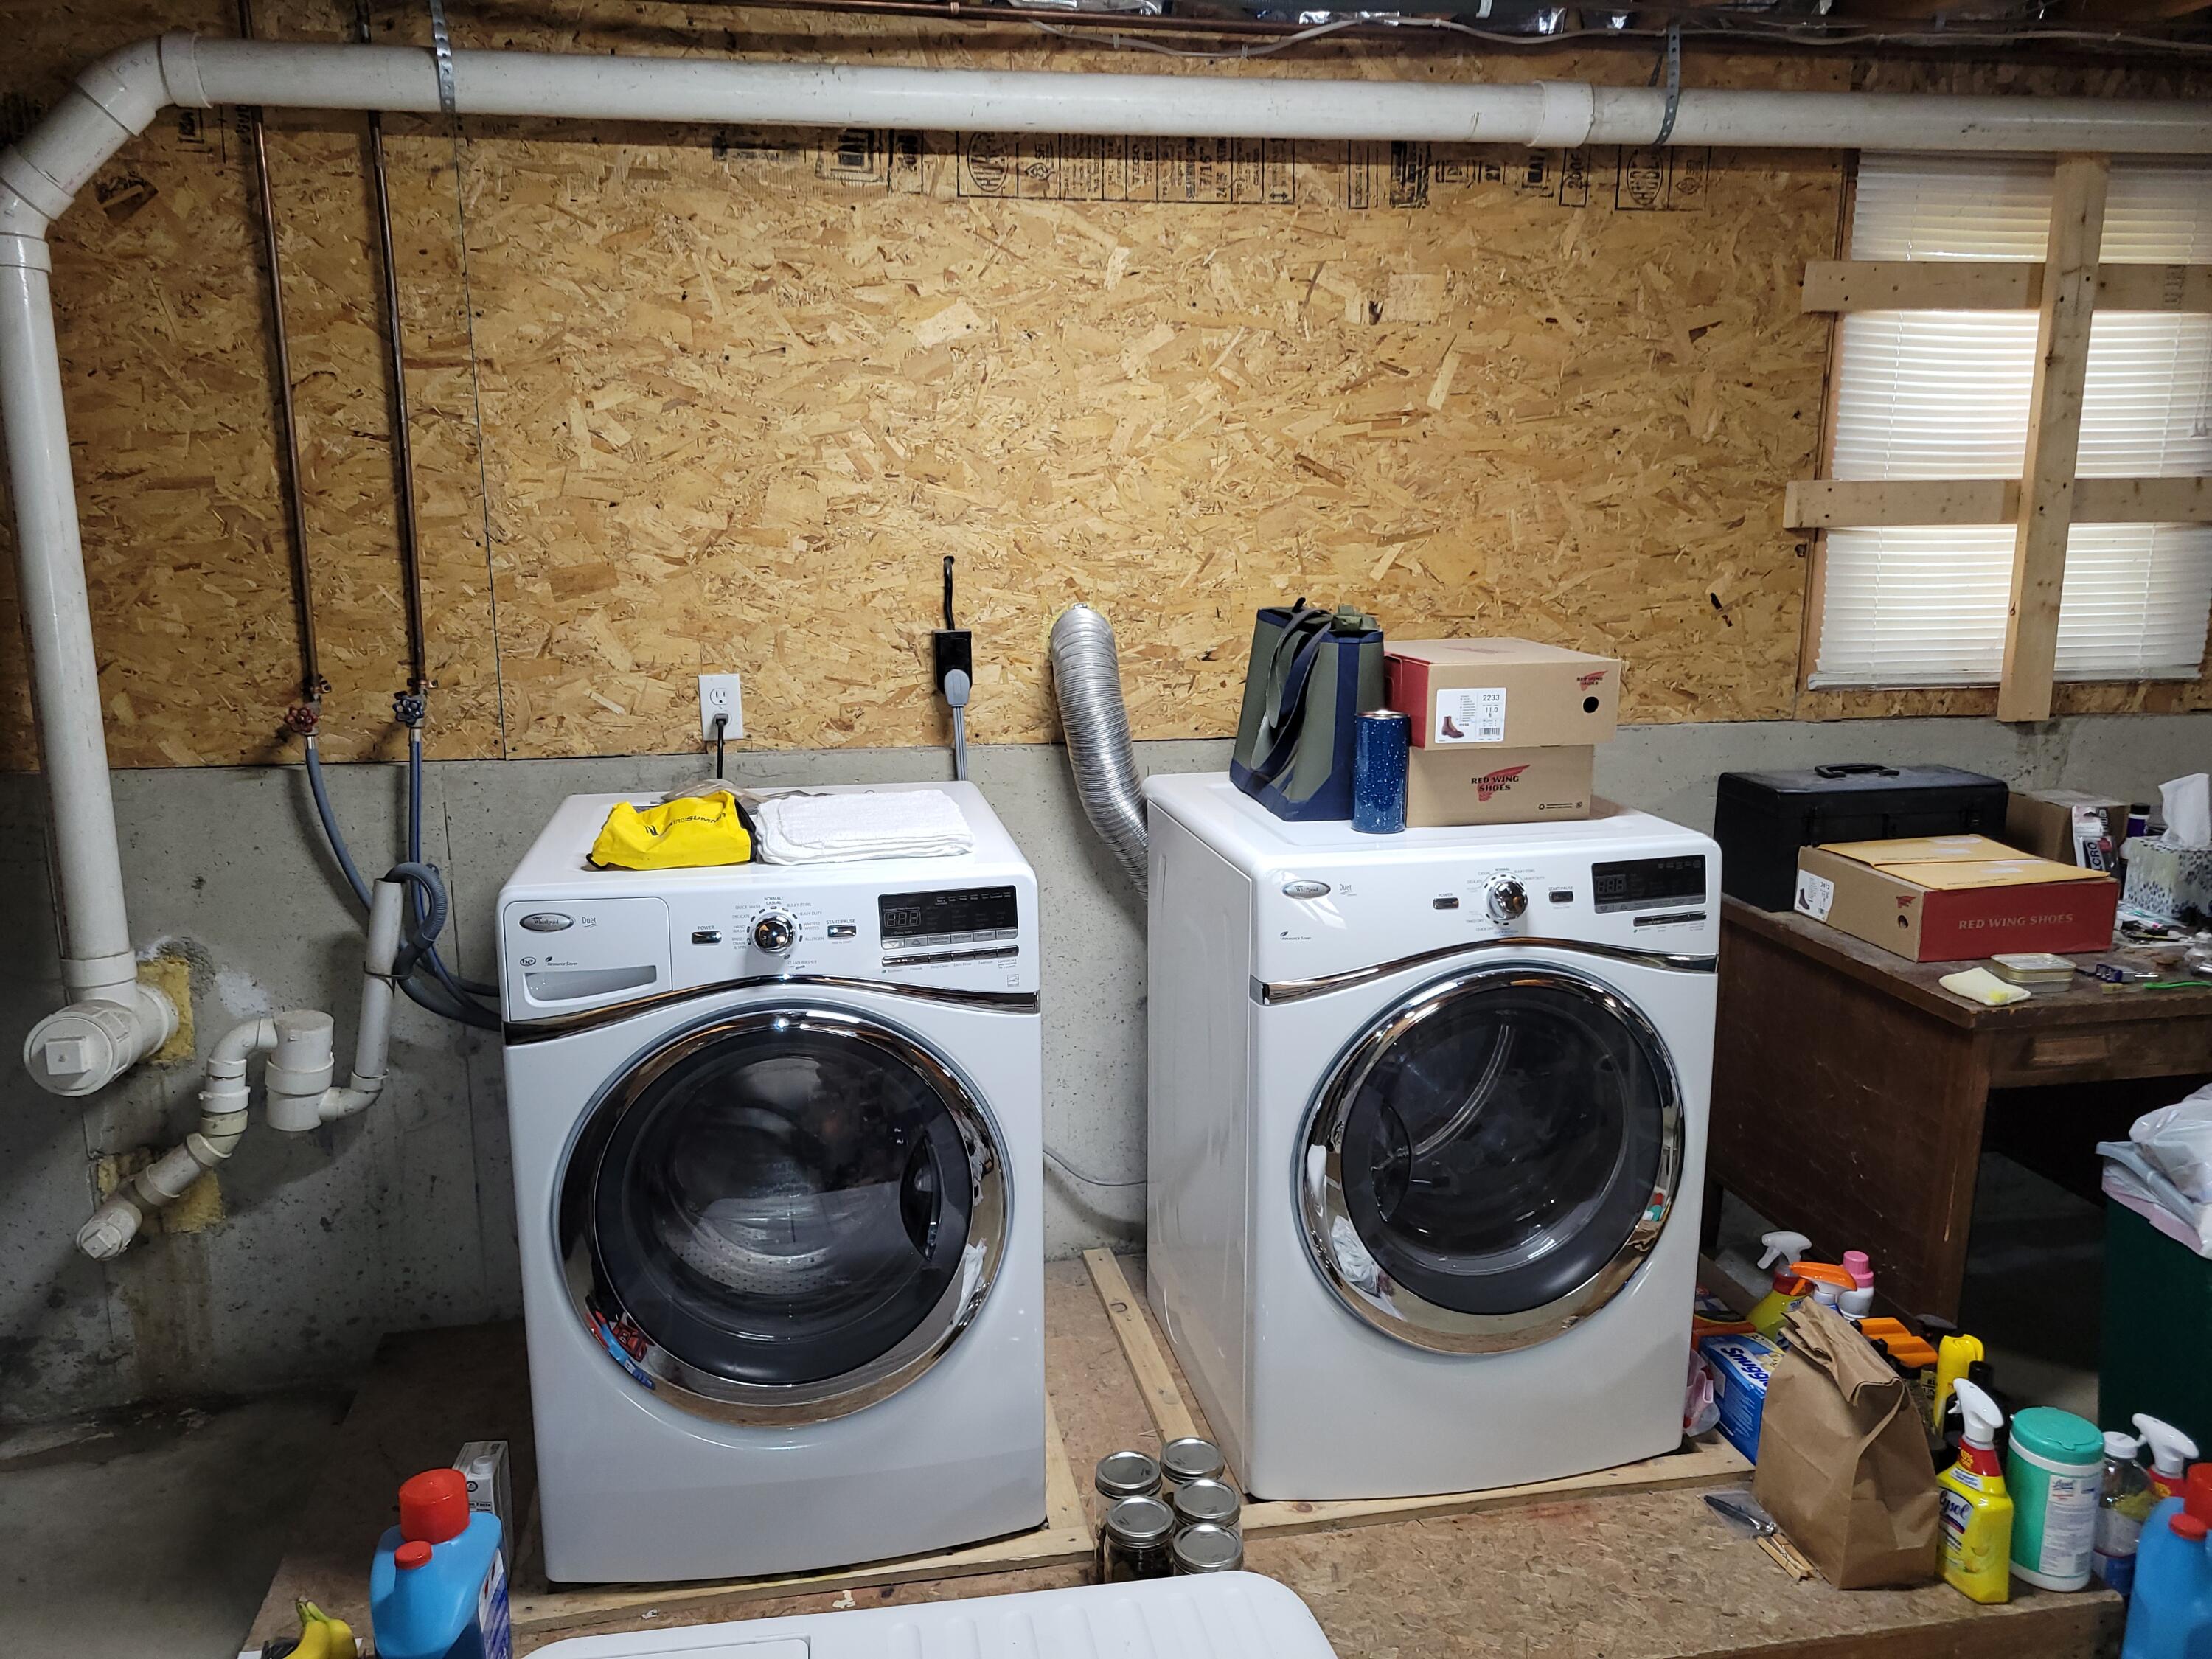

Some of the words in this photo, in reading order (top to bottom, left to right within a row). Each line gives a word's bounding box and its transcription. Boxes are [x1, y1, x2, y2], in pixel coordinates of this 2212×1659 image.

[1471, 776, 1489, 785] RED
[1492, 775, 1520, 783] WING
[1478, 784, 1511, 792] SHOES
[532, 917, 560, 926] Whirlpool
[1958, 919, 1985, 929] RED
[1989, 917, 2025, 927] WING
[2029, 914, 2074, 925] SHOES
